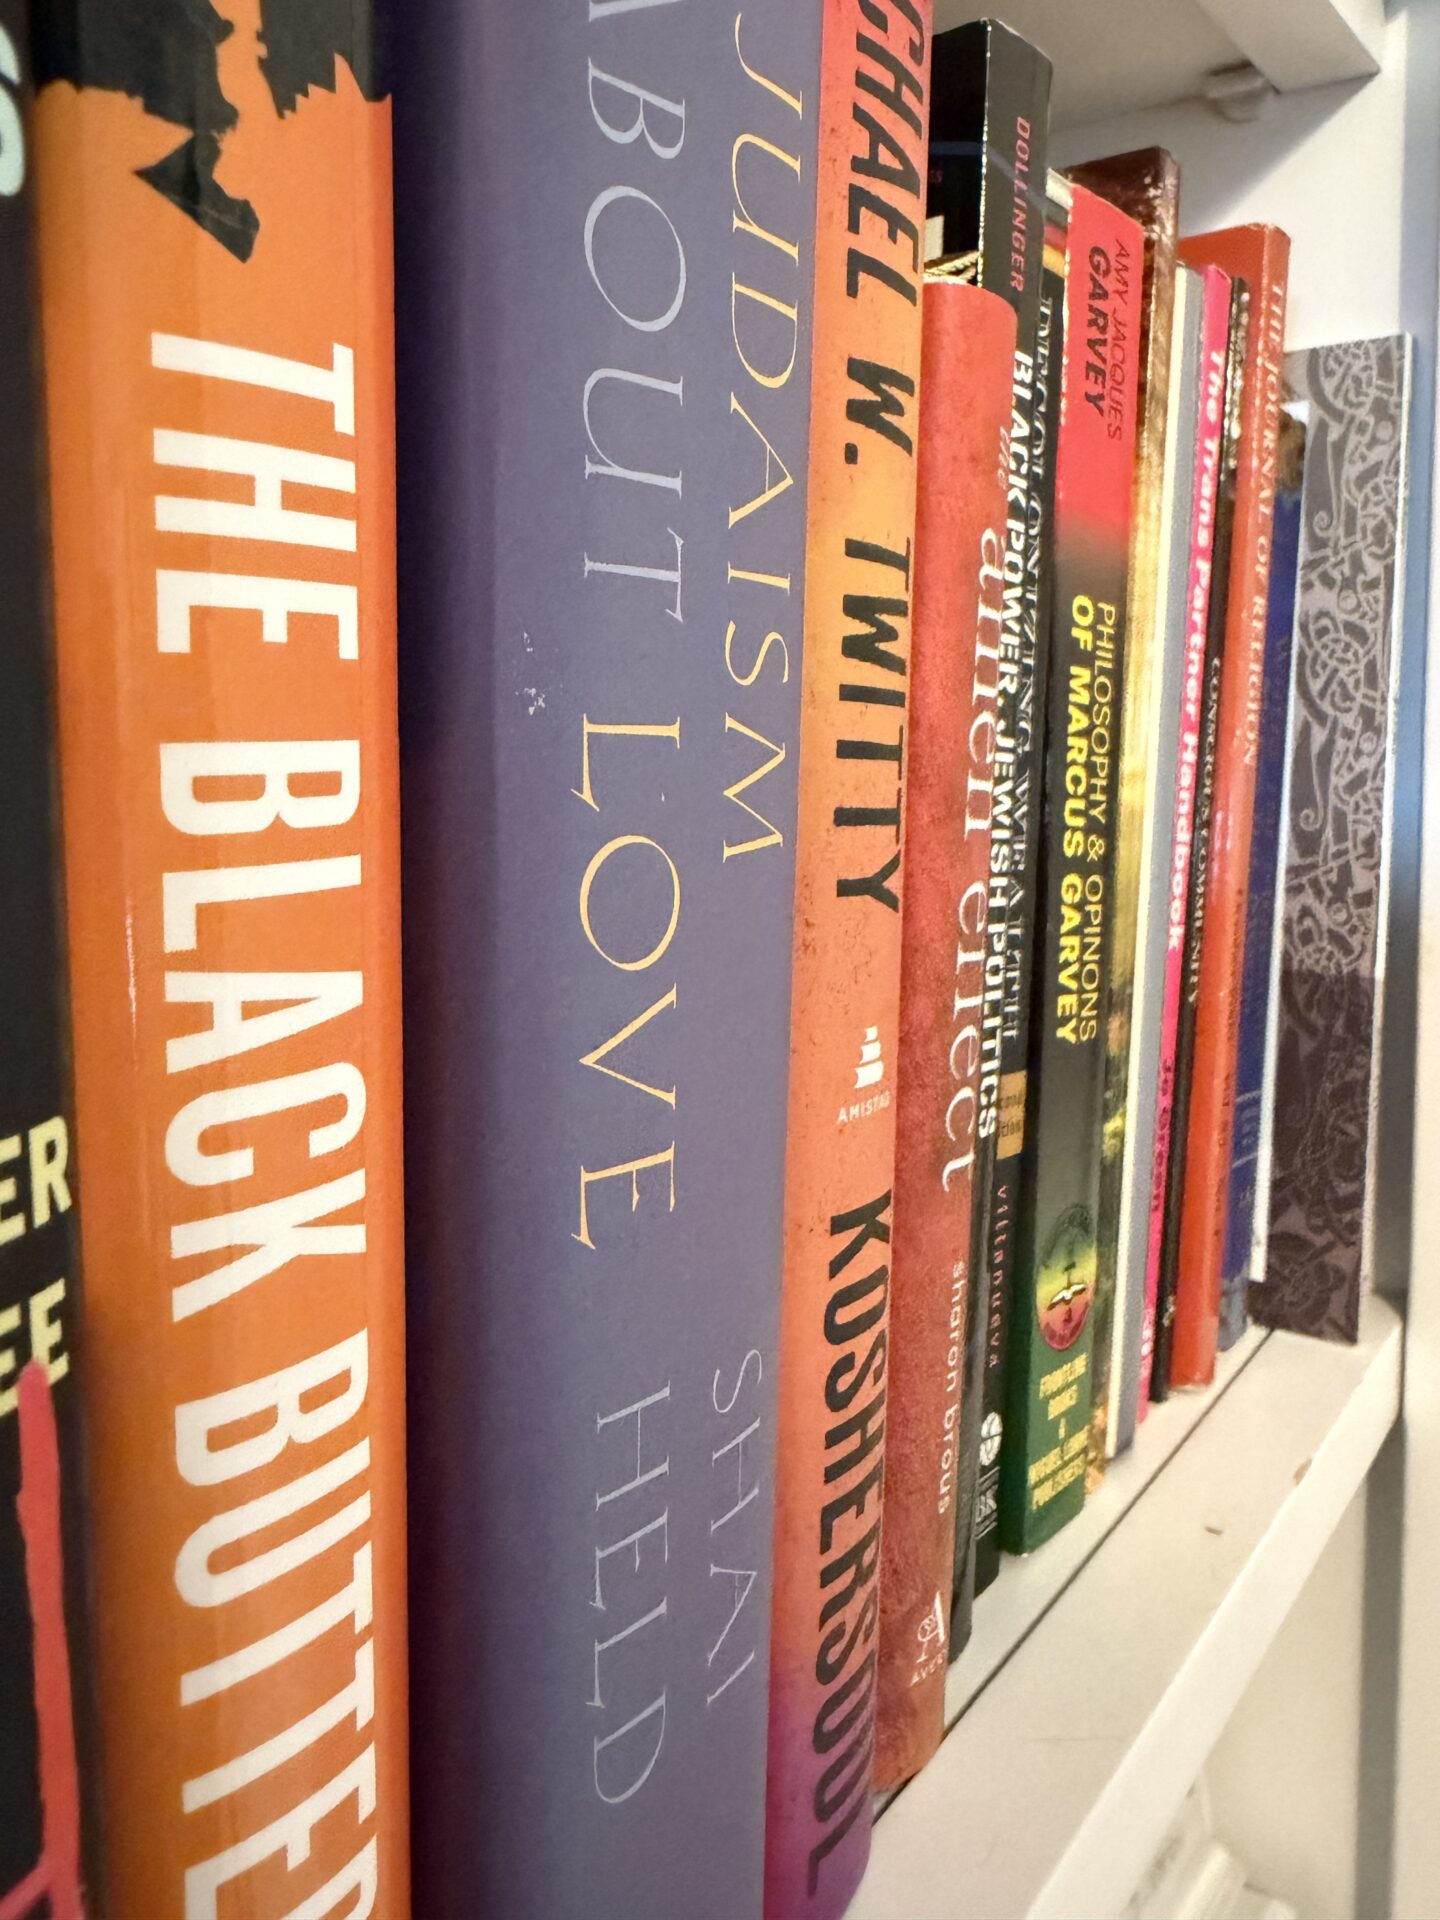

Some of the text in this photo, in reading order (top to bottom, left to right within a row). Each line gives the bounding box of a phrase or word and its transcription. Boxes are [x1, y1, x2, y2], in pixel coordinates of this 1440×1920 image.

[1010, 115, 1032, 293] DOLLINGER
[1084, 246, 1112, 418] GARVEY
[1107, 238, 1131, 441] AMY JACQUES
[150, 331, 359, 660] THE
[722, 11, 802, 863] JUDAISM
[844, 355, 917, 465] W.
[1005, 349, 1035, 516] BLACK
[571, 0, 687, 1250] BOUT LOVE
[832, 536, 912, 914] TWITTY
[964, 526, 1006, 842] amen
[1088, 601, 1116, 825] PHILOSOPHY
[1167, 351, 1225, 952] The Trans Partner Handbook
[987, 716, 1016, 907] JEWISH
[1055, 594, 1094, 1045] OF MARCUS GARVEY
[1086, 833, 1106, 863] &
[159, 739, 368, 1323] BLACK
[977, 922, 1007, 1139] POLITICS
[707, 1350, 763, 1708] SHAI
[805, 1187, 892, 1898] KOSHERSOUL
[937, 1260, 966, 1516] sharon brous
[586, 1380, 671, 1803] HELD
